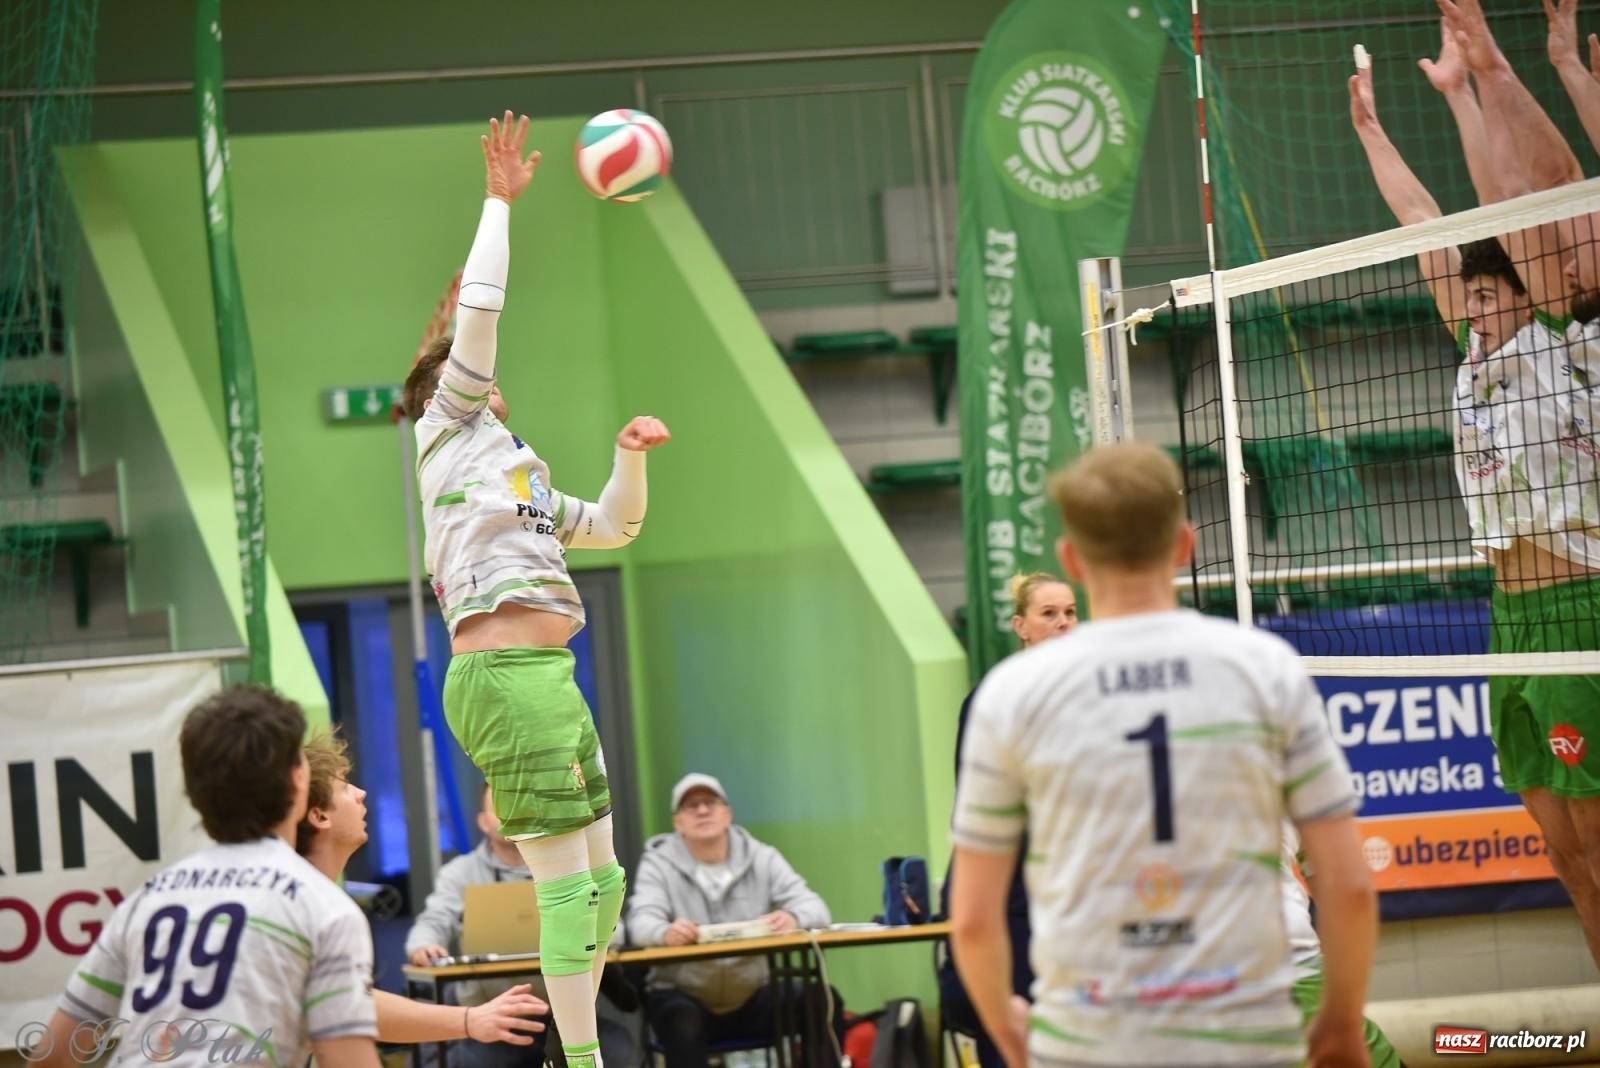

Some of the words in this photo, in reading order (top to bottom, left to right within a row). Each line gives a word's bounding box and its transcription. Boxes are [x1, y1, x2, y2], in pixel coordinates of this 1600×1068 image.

[998, 69, 1041, 119] KLUB
[1041, 63, 1127, 146] SIATKARSKI
[1013, 320, 1054, 556] RACIBÓRZ
[986, 519, 1018, 633] KLUB
[1097, 656, 1192, 696] LABER
[1325, 681, 1493, 748] CZENI
[0, 750, 160, 876] IN
[1123, 712, 1175, 844] 1
[1394, 829, 1548, 868] ubezpiec
[131, 901, 247, 1014] 99
